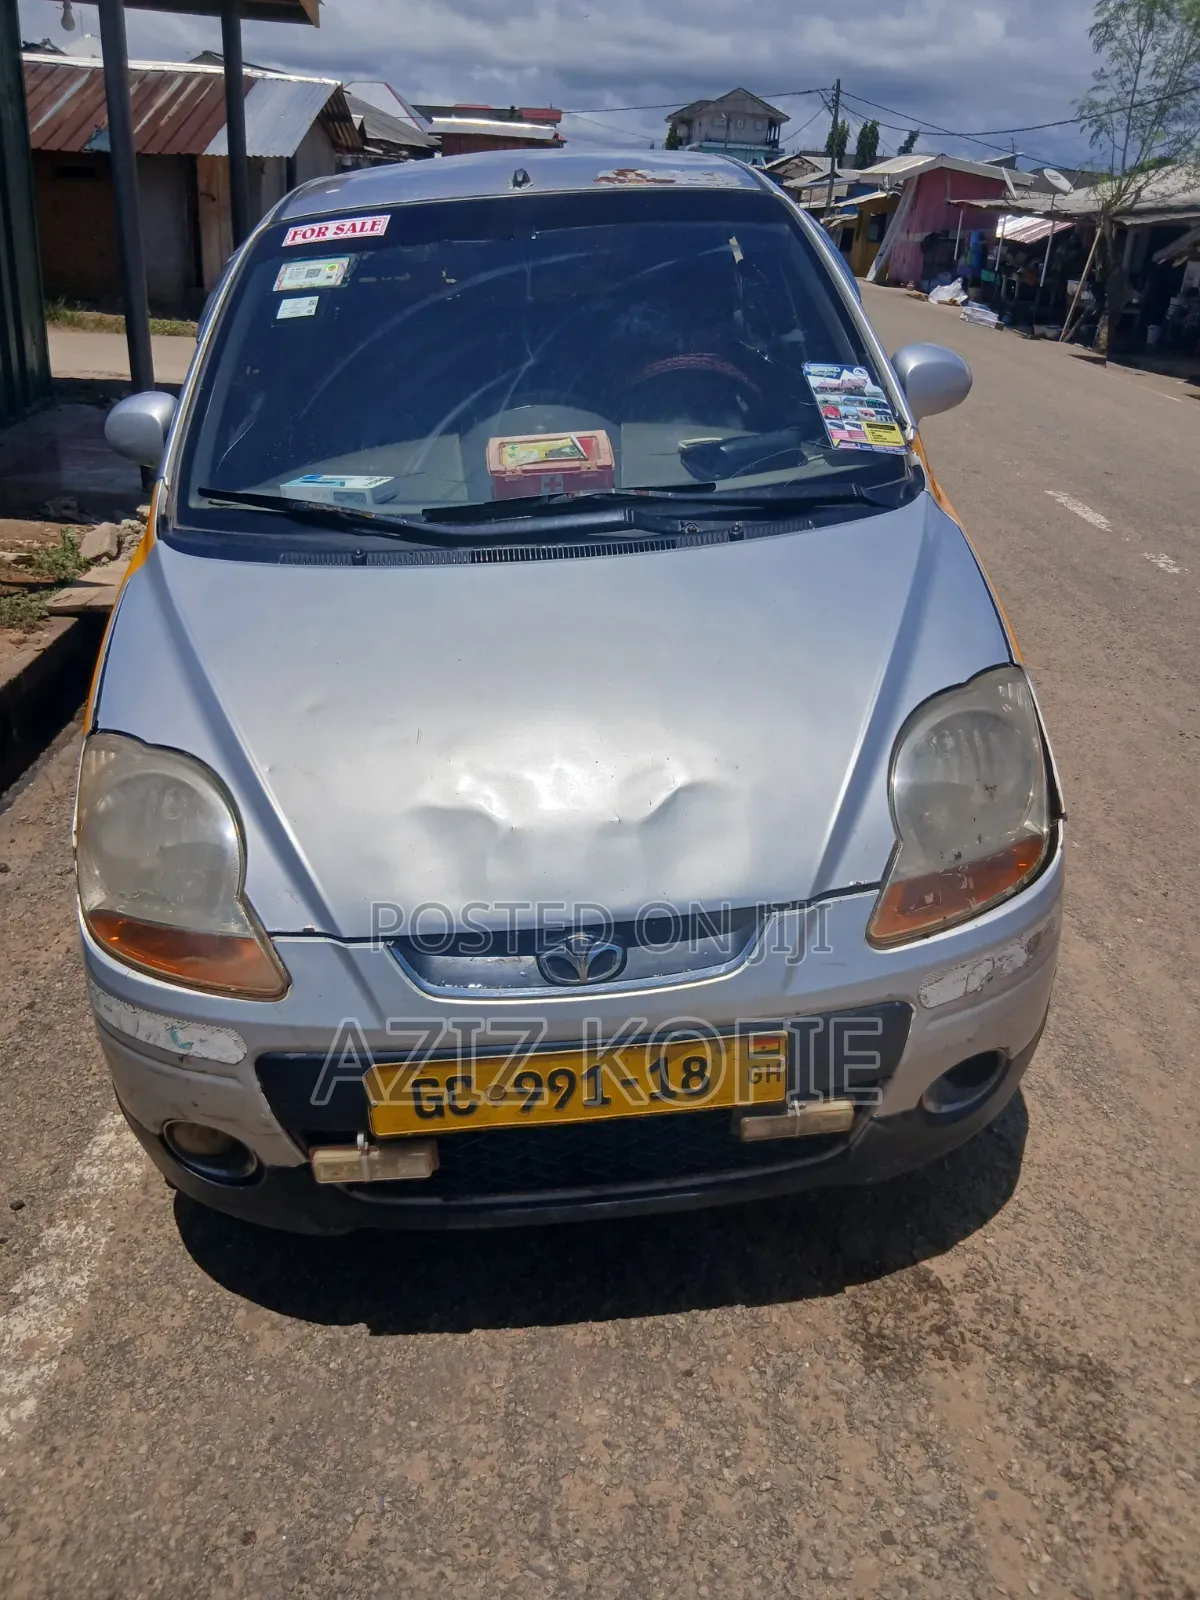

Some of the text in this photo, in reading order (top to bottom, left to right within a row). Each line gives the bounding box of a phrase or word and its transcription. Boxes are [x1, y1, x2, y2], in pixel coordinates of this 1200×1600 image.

[290, 220, 382, 241] FOR SALE
[747, 1064, 781, 1085] GH
